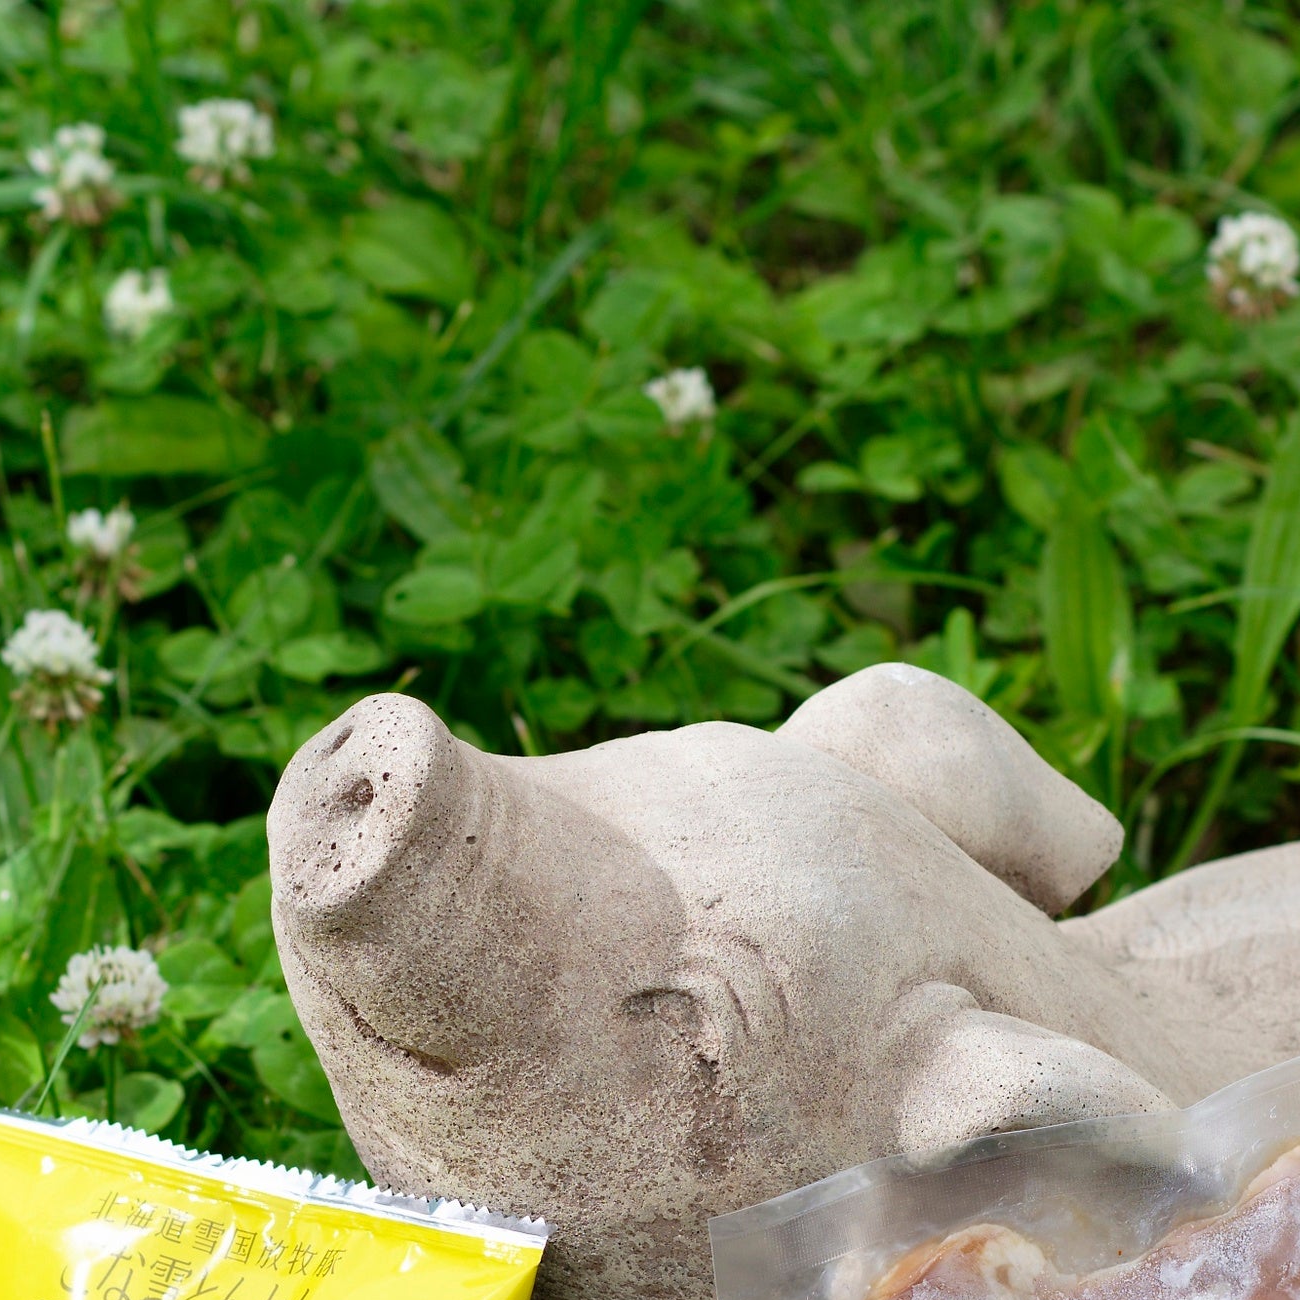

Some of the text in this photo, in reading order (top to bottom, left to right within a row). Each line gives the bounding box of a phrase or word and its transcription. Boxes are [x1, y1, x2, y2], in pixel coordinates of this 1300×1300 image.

[91, 1190, 347, 1280] 北海道雪国放牧豚
